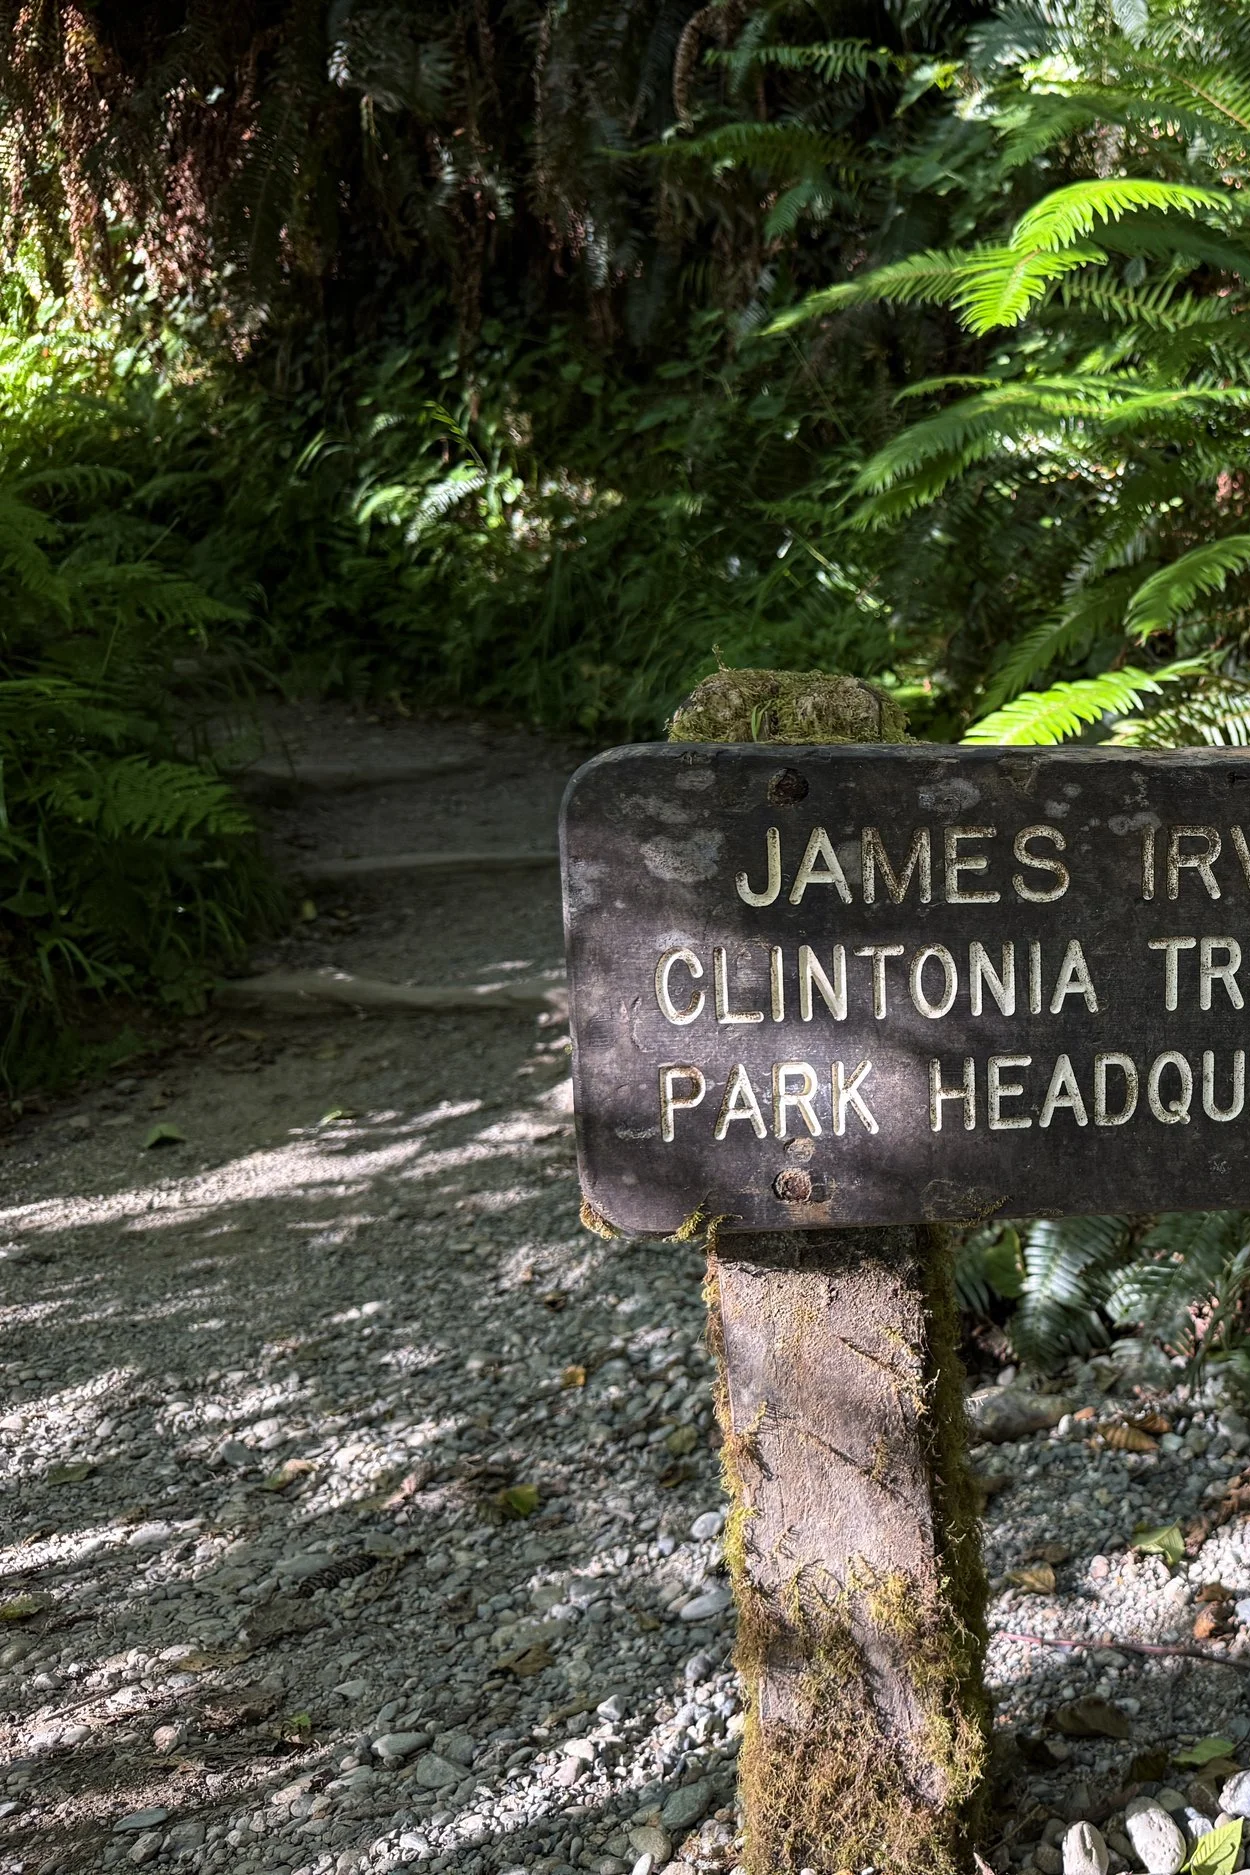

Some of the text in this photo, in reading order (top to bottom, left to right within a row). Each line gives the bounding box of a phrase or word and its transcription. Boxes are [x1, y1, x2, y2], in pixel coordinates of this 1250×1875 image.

[734, 824, 1071, 908] JAMES
[654, 938, 1099, 1026] CLINTONIA
[658, 1059, 880, 1143] PARK
